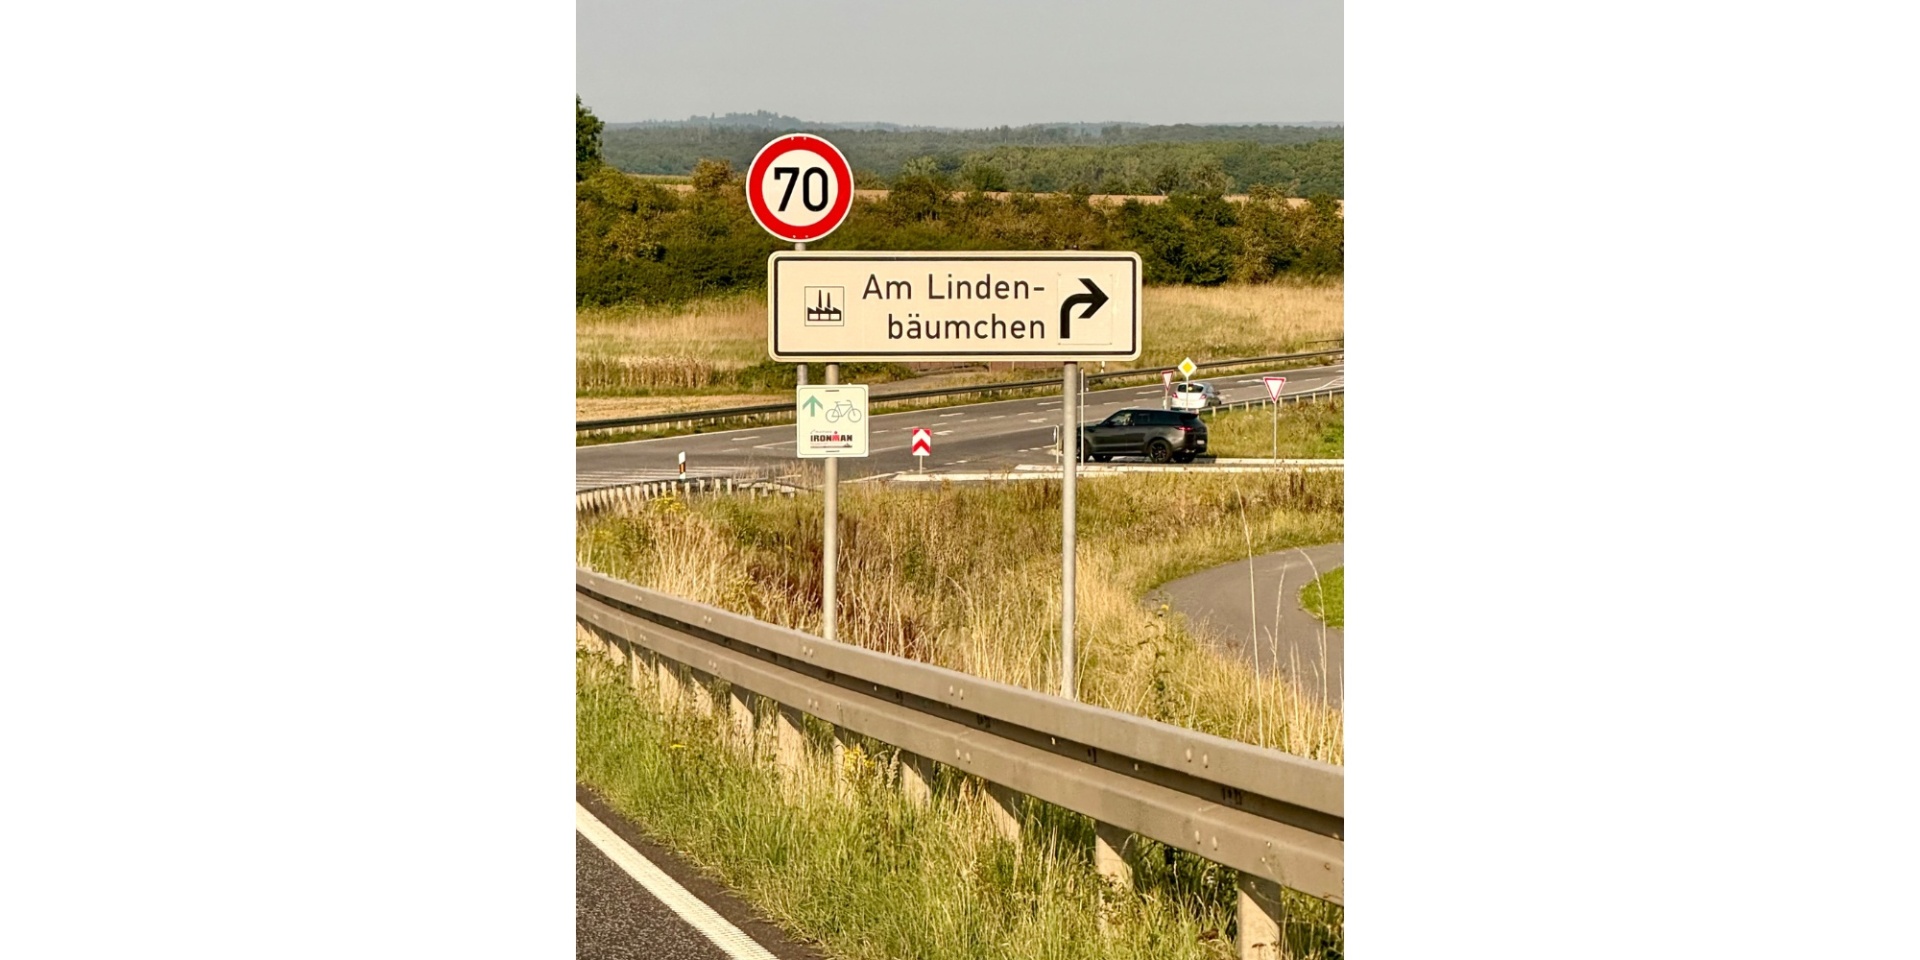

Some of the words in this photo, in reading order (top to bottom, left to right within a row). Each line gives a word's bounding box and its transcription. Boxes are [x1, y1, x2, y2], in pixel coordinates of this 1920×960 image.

[774, 166, 828, 212] 70
[862, 273, 912, 300] Am
[928, 273, 1045, 300] Linden-
[888, 313, 1046, 340] bäumchen
[810, 432, 853, 442] IRONMAN
